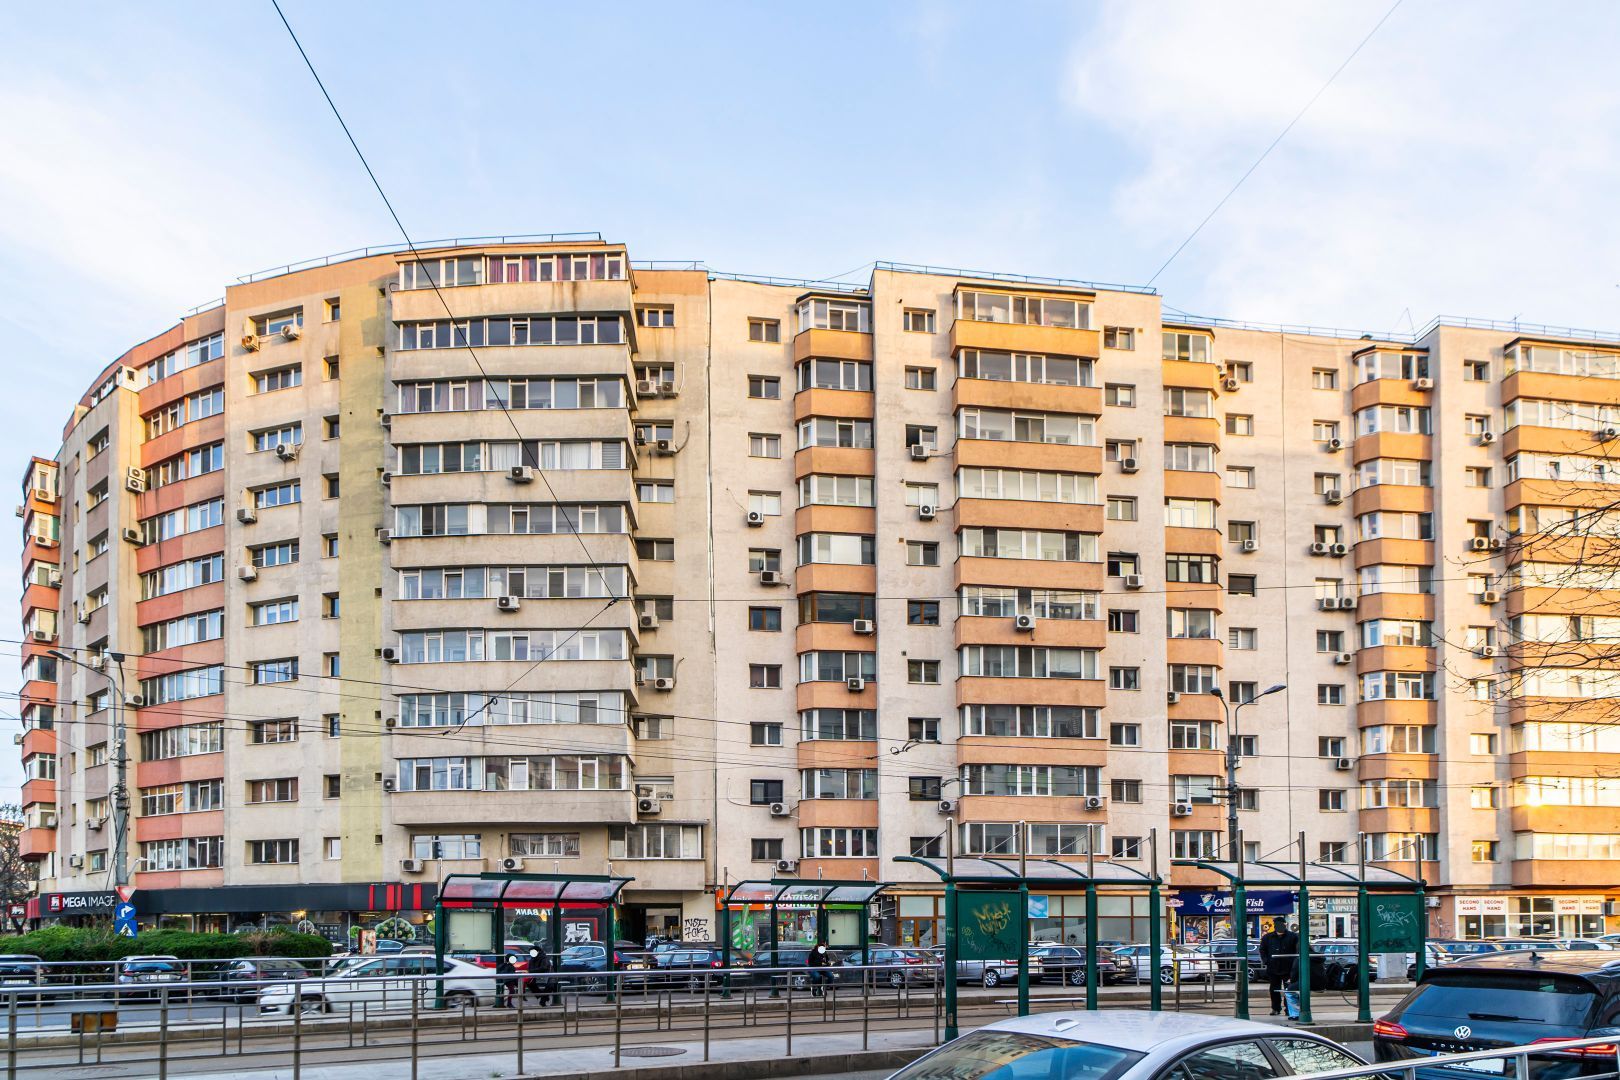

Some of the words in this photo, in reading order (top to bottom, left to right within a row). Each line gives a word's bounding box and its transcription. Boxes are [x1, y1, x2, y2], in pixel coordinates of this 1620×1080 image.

[62, 896, 87, 908] MEGA
[88, 895, 115, 907] IMAGE
[1246, 898, 1264, 907] Fish
